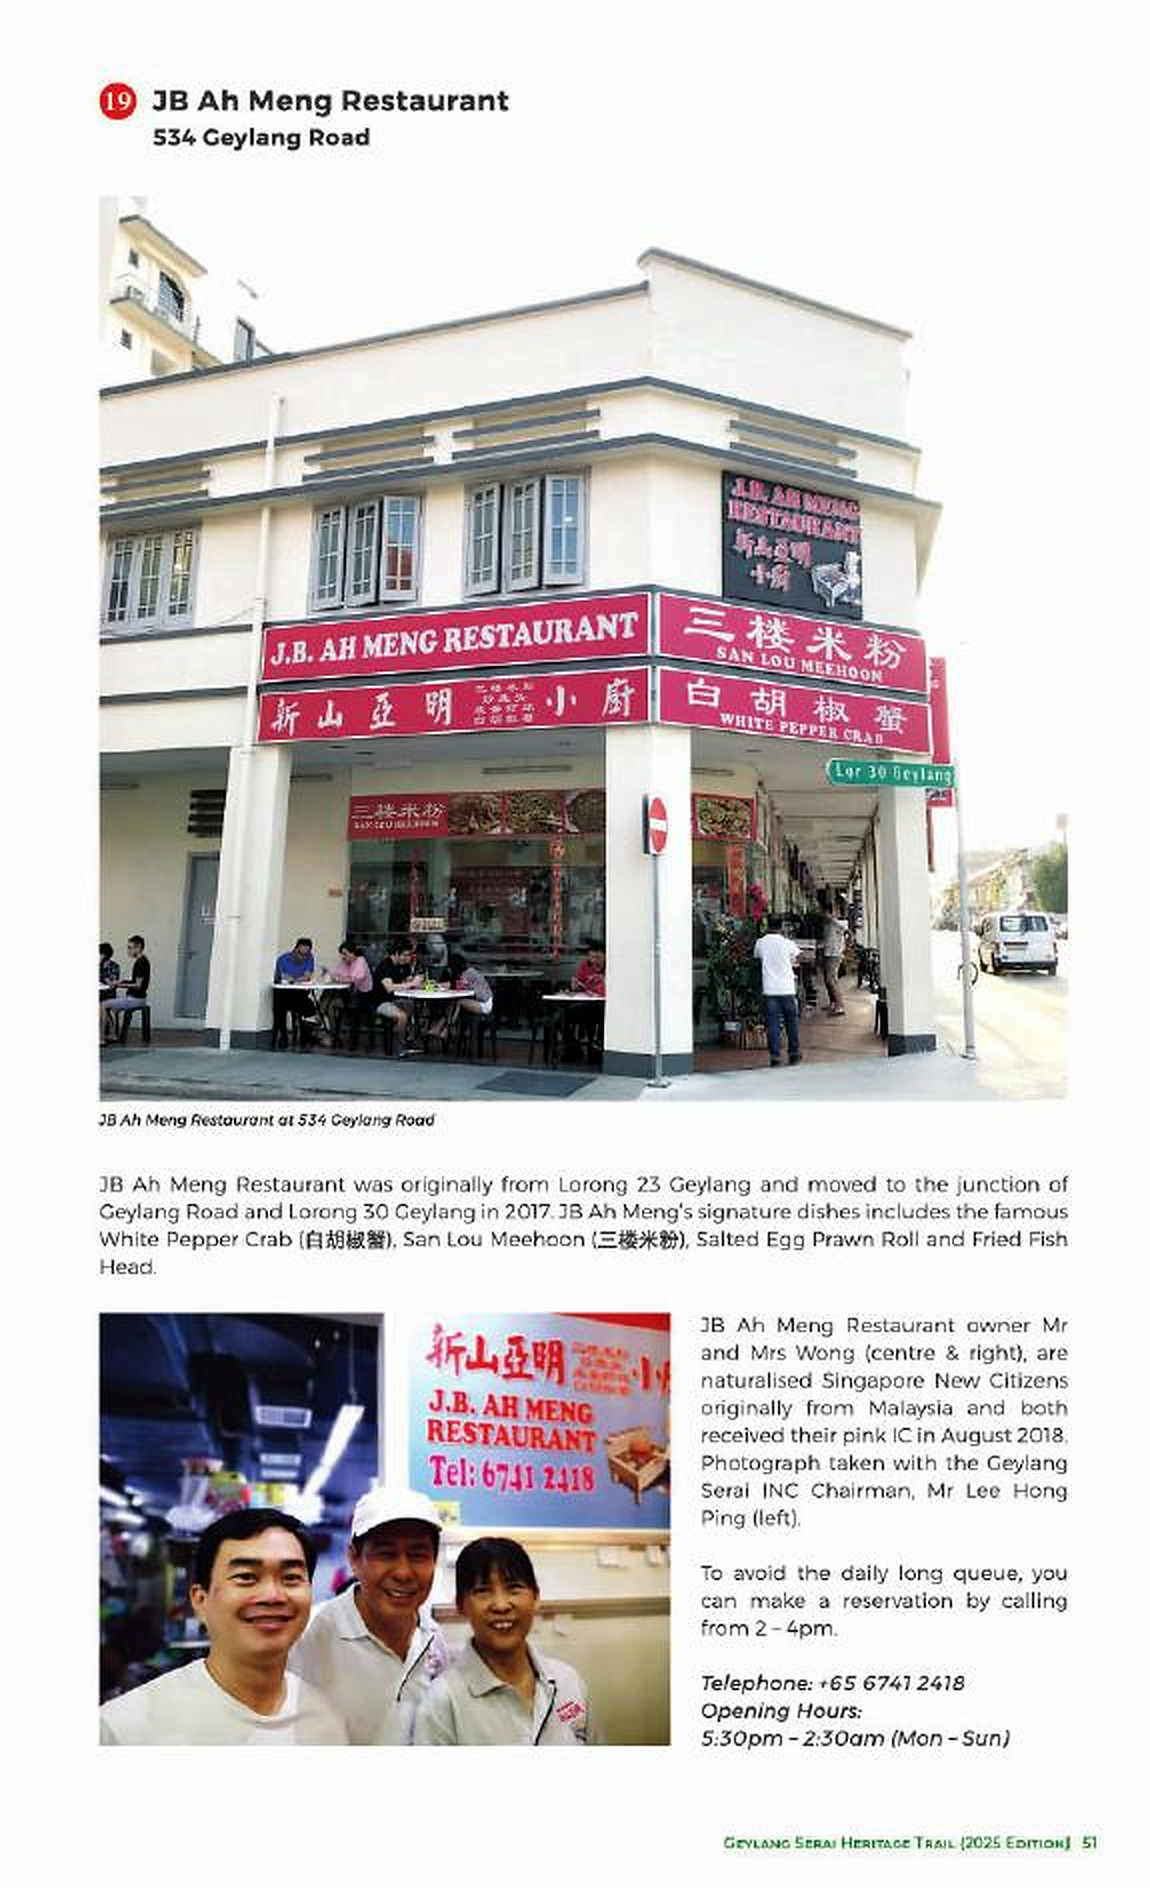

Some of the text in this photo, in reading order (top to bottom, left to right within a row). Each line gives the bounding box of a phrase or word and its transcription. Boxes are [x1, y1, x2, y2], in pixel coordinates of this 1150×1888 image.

[104, 91, 131, 112] 19
[152, 89, 509, 118] JB Ah Meng Restaurant
[153, 127, 370, 152] 534 Geylang Road
[270, 611, 639, 666] J.B. AH MENG RESTAURANT
[683, 606, 907, 671] 三楼米粉
[716, 645, 884, 684] SAN LOU MEEHOON
[686, 677, 908, 735] 白胡椒蟹
[720, 712, 884, 745] WHITE PEPPER CRAB
[835, 761, 953, 787] Lor 30 Geylang
[98, 1113, 435, 1129] JB Ah Meng Restaurant at 534 Geylang Road
[99, 1175, 1069, 1197] JB Ah Meng Restaurant was originally from Lorong 23 Geylang and moved to the junction of
[99, 1203, 180, 1225] Geylang
[186, 1203, 239, 1220] Road
[244, 1202, 283, 1220] and
[289, 1202, 358, 1226] Lorong
[363, 1203, 389, 1220] 30
[395, 1203, 476, 1225] Geylang
[481, 1203, 499, 1219] in
[504, 1203, 556, 1221] 2017.
[558, 1203, 583, 1221] JB
[588, 1203, 618, 1221] Ah
[698, 1203, 791, 1225] signature
[797, 1202, 861, 1219] dishes
[866, 1203, 951, 1219] includes
[956, 1203, 989, 1220] the
[994, 1202, 1069, 1220] famous
[99, 1231, 159, 1247] White
[167, 1231, 239, 1251] Pepper
[245, 1230, 293, 1247] Crab
[403, 1231, 441, 1247] San
[447, 1231, 482, 1247] Lou
[491, 1230, 585, 1247] Meehoon
[697, 1230, 759, 1247] Salted
[767, 1231, 805, 1251] Egg
[813, 1231, 875, 1247] Prawn
[882, 1231, 919, 1247] Roll
[926, 1231, 965, 1247] and
[972, 1230, 1022, 1247] Fried
[1029, 1231, 1068, 1247] Fish
[100, 1259, 157, 1275] Head.
[425, 1321, 566, 1386] 新山亞明
[701, 1343, 1068, 1365] and Mrs Wong (centre & right), are
[428, 1389, 594, 1425] J.B. AH MENG
[426, 1418, 597, 1454] RESTAURANT
[701, 1426, 1068, 1447] received their pink IC in August 2018.
[429, 1454, 595, 1493] Tel: 6741 2418
[701, 1482, 1068, 1503] Serai INC Chairman, Mr Lee Hong
[702, 1509, 800, 1530] Ping (left).
[700, 1564, 1068, 1585] To avoid the daily long queue, you
[701, 1619, 749, 1637] from
[755, 1619, 767, 1637] 2
[786, 1619, 837, 1640] 4pm.
[701, 1673, 965, 1695] Telephone: +65 6741 2418
[701, 1702, 863, 1723] Opening Hours:
[701, 1729, 783, 1751] 5:30pm
[802, 1729, 885, 1747] 2:30am
[891, 1729, 943, 1749] (Mon
[962, 1729, 1011, 1749] Sun)
[1082, 1836, 1097, 1849] 51
